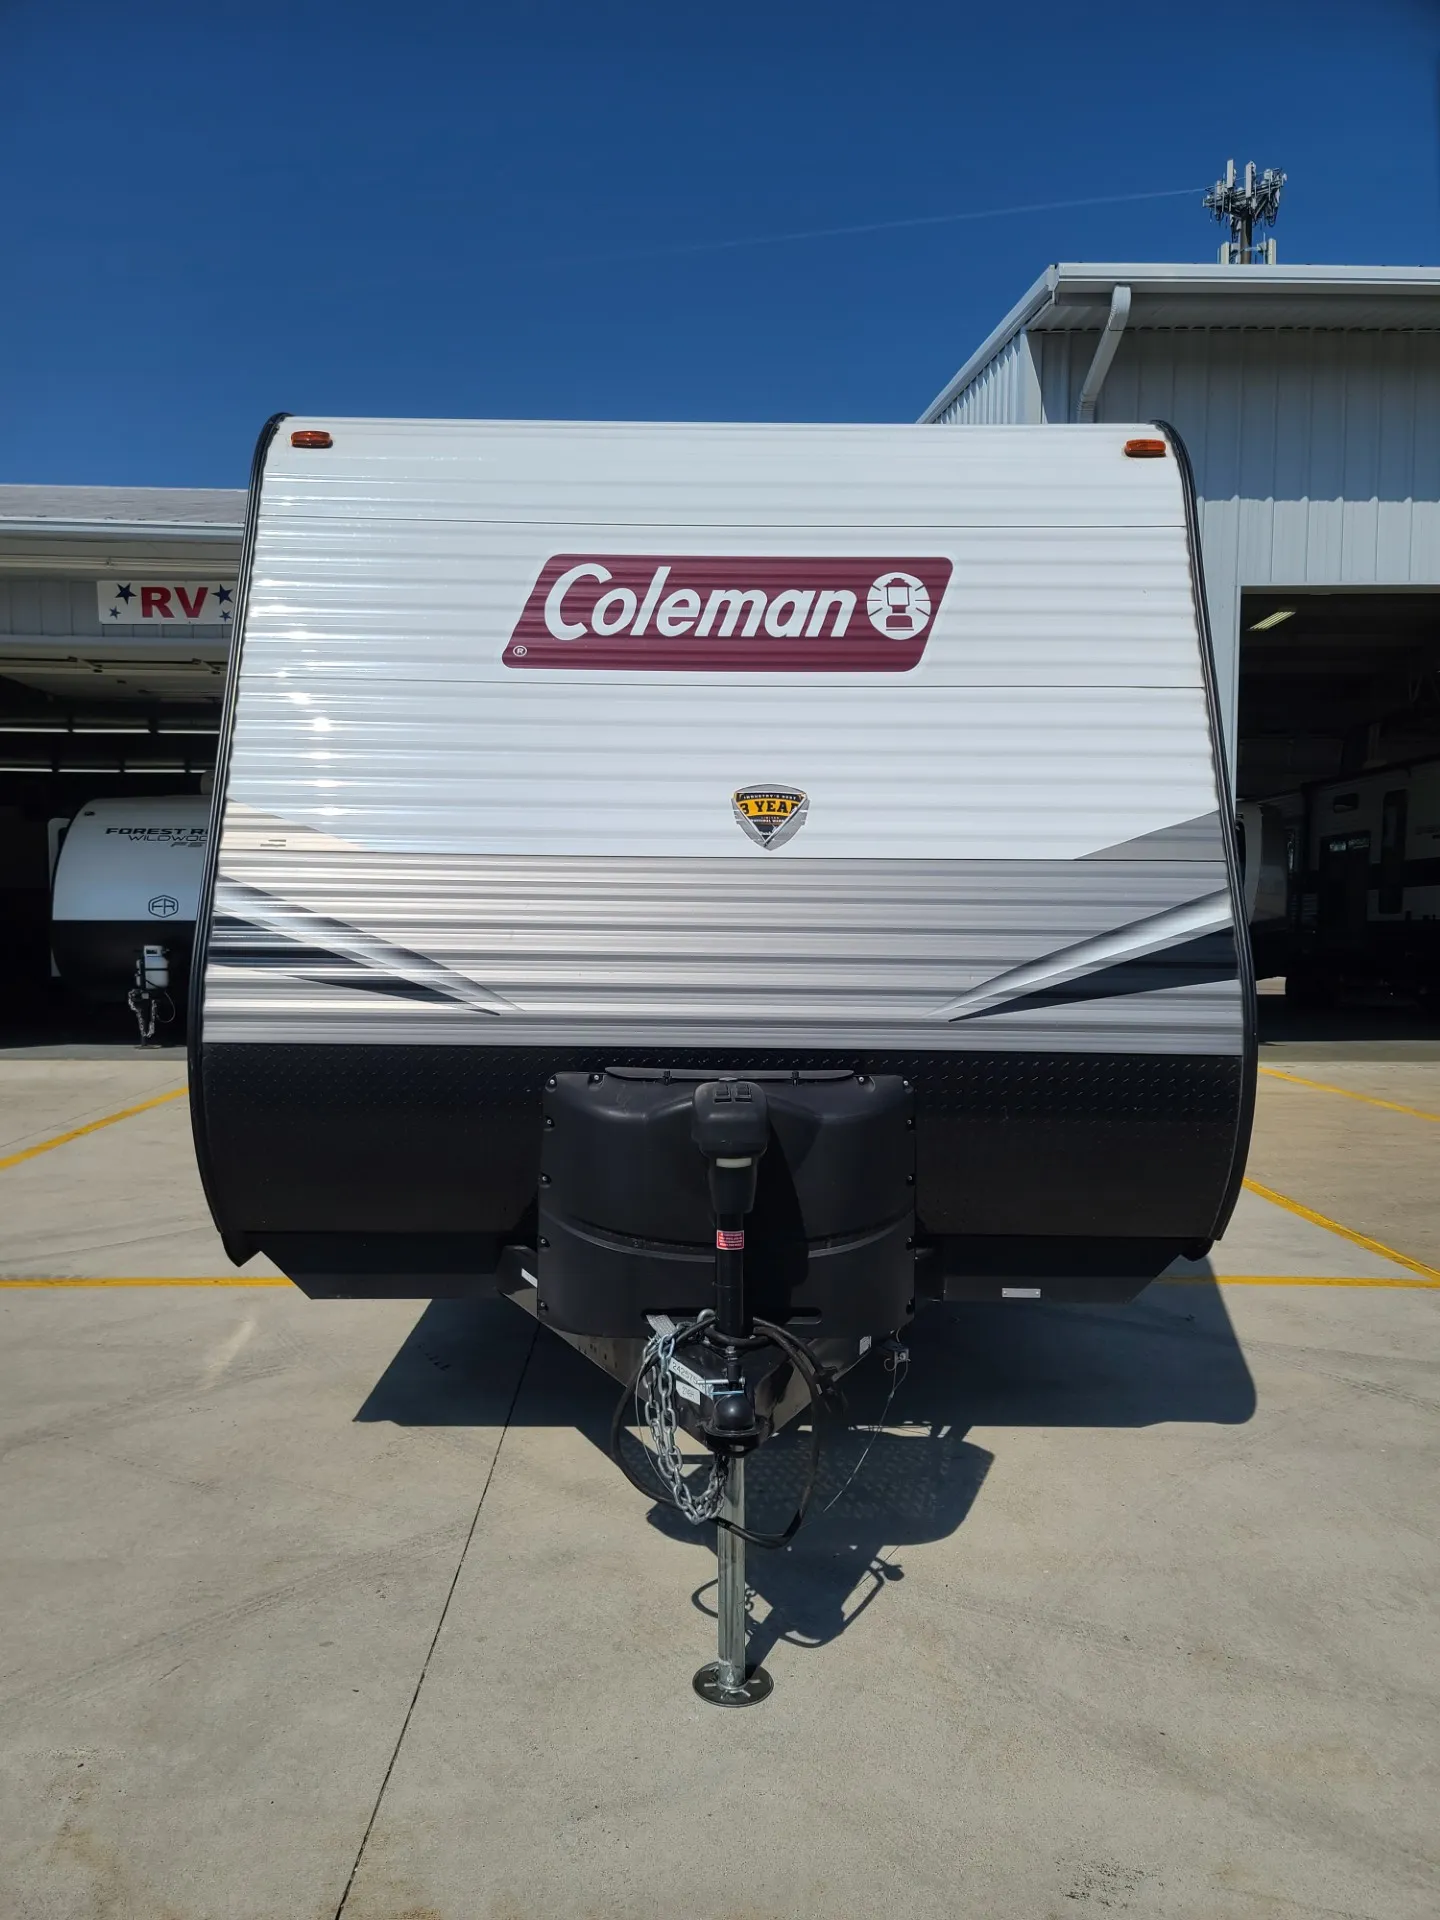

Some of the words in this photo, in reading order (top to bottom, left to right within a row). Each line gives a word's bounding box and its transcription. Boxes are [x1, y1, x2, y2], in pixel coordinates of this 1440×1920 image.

[140, 586, 209, 618] RV
[543, 562, 857, 641] Coleman
[740, 803, 749, 815] 3
[105, 827, 187, 835] FOREST
[128, 834, 208, 842] WILDWOO
